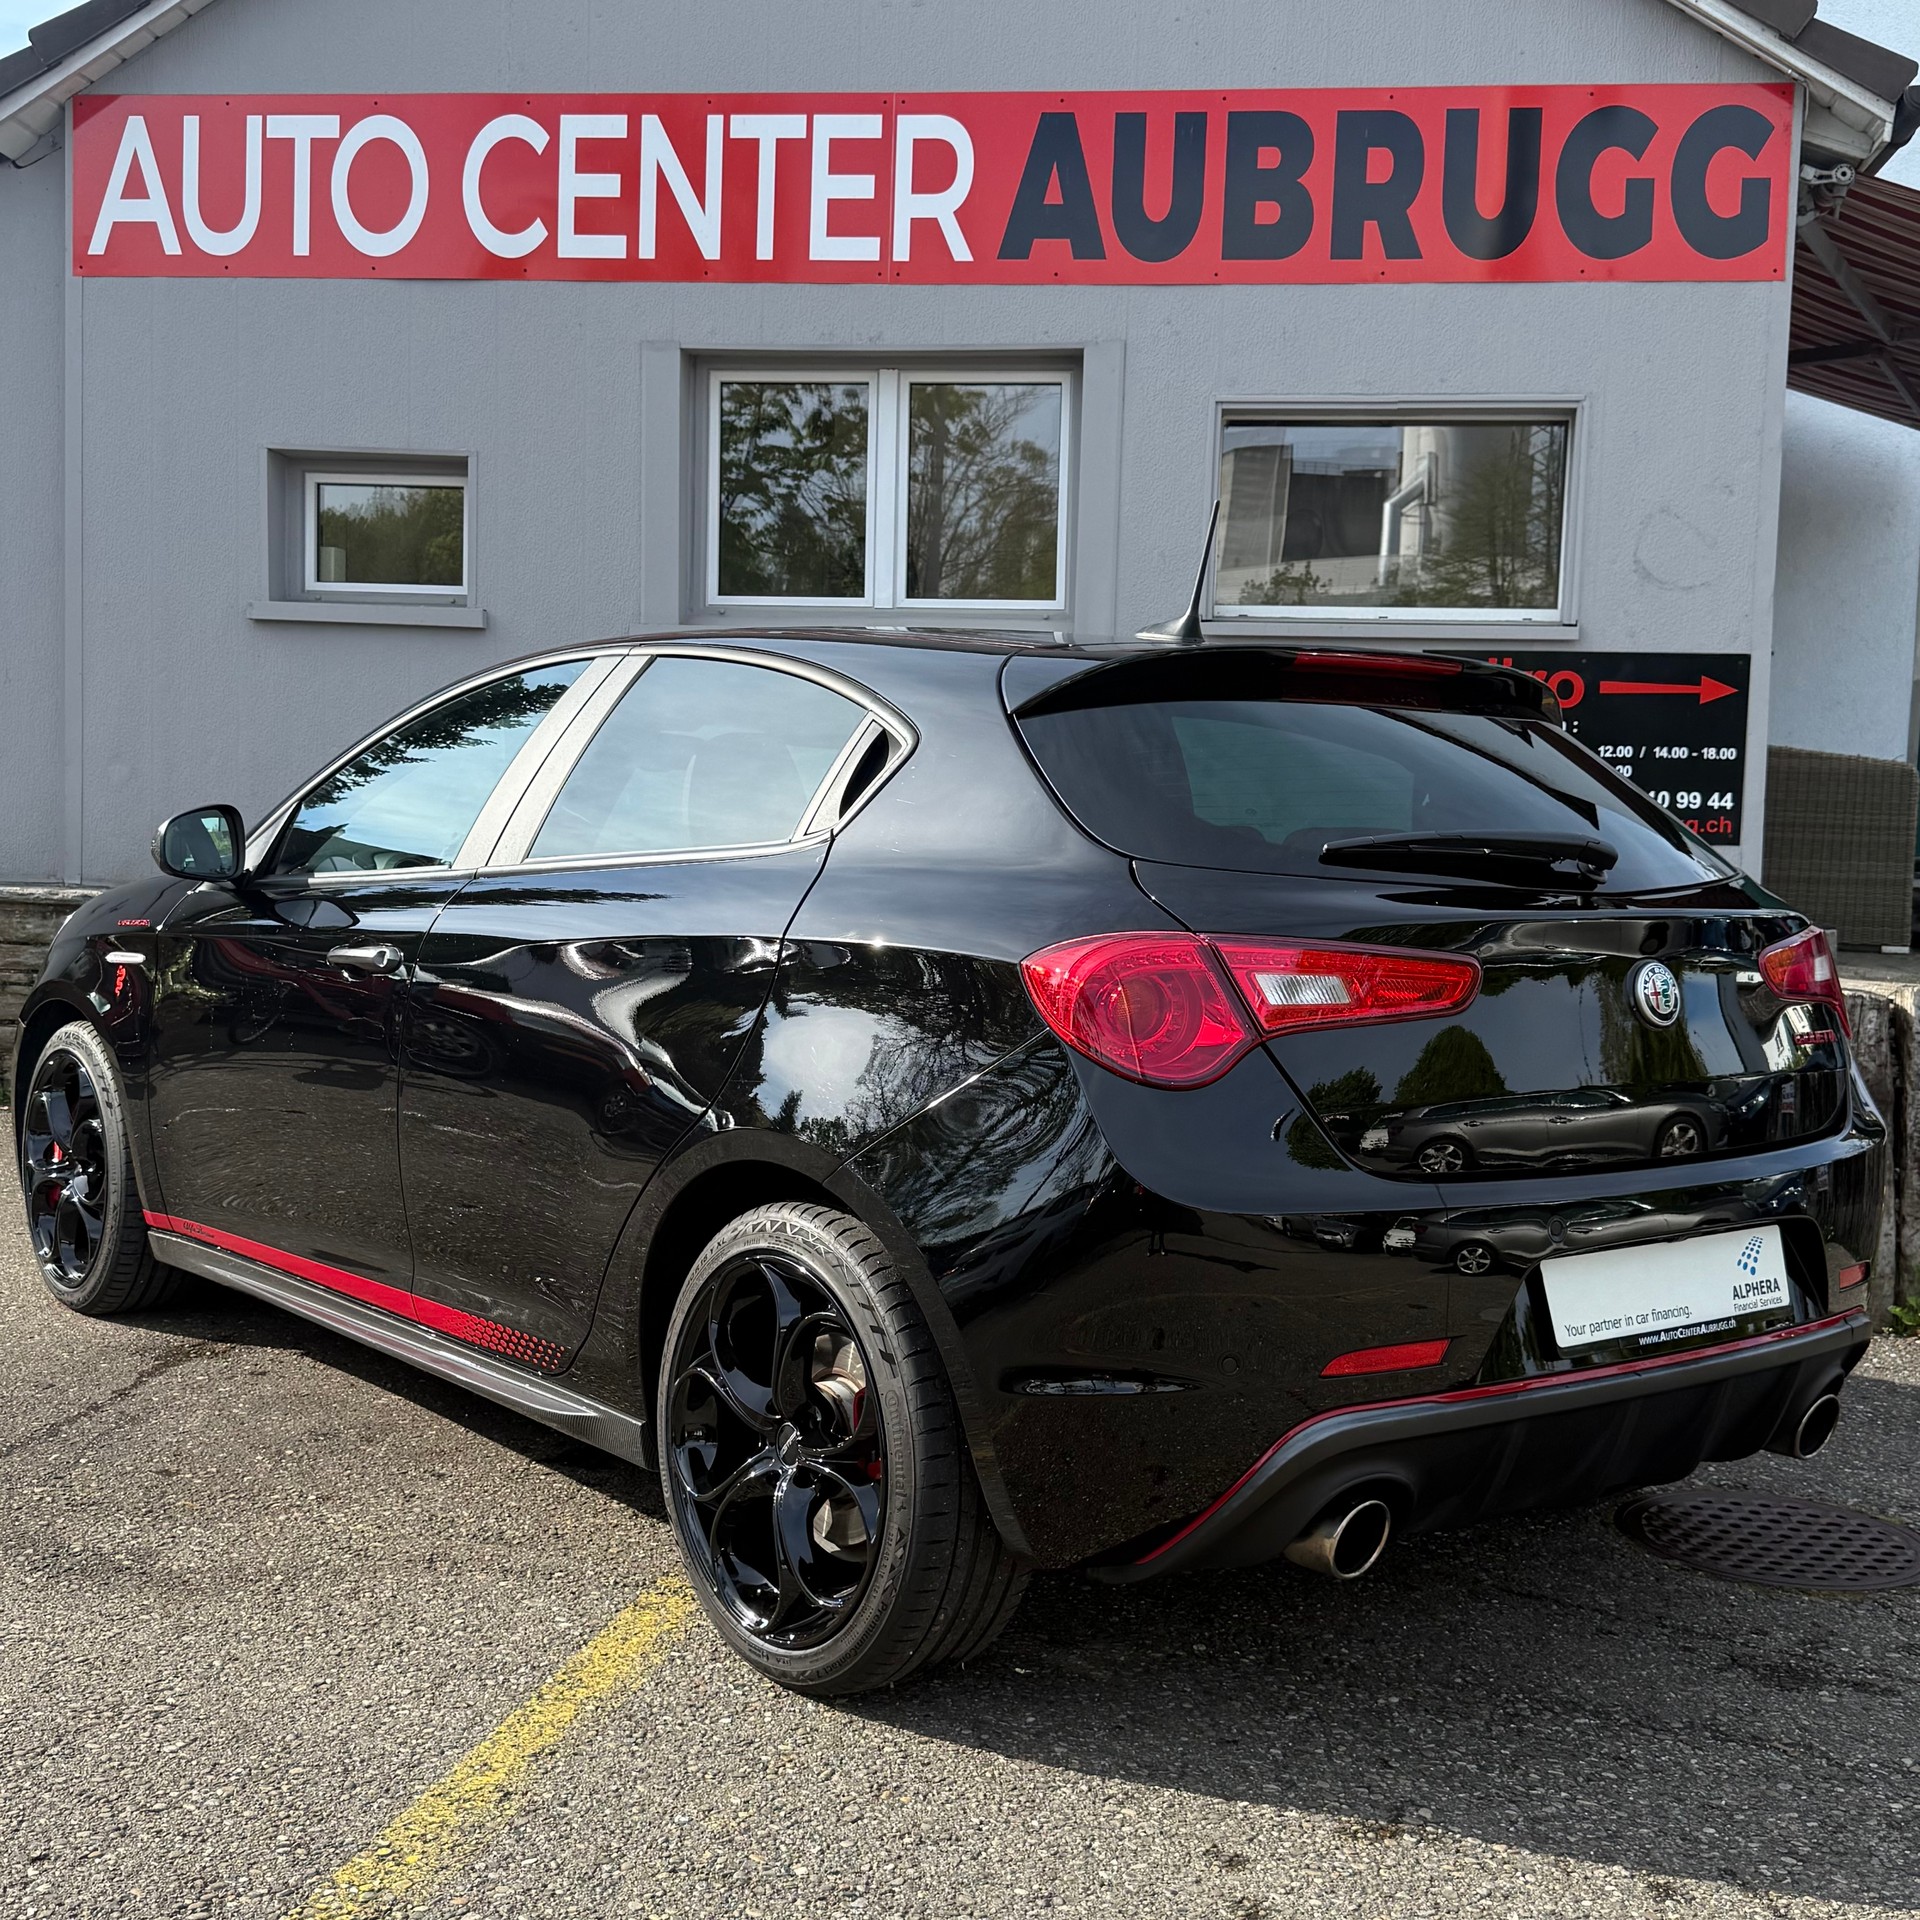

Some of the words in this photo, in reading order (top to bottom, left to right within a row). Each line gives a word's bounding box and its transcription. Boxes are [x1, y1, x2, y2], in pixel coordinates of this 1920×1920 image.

[87, 113, 429, 257] AUTO
[462, 113, 975, 262] CENTER
[997, 103, 1776, 264] AUBRUGG
[1598, 745, 1633, 758] 12.00
[1653, 746, 1689, 759] 14.00
[1701, 747, 1737, 760] 18.00
[1676, 791, 1701, 809] 99
[1706, 791, 1734, 810] 44
[1733, 1277, 1781, 1300] ALPHERA
[1733, 1299, 1758, 1312] Financial
[1760, 1296, 1783, 1308] Services
[1564, 1323, 1587, 1338] Your
[1589, 1317, 1622, 1336] partner
[1625, 1315, 1634, 1327] in
[1636, 1312, 1649, 1324] car
[1651, 1305, 1692, 1321] financing.
